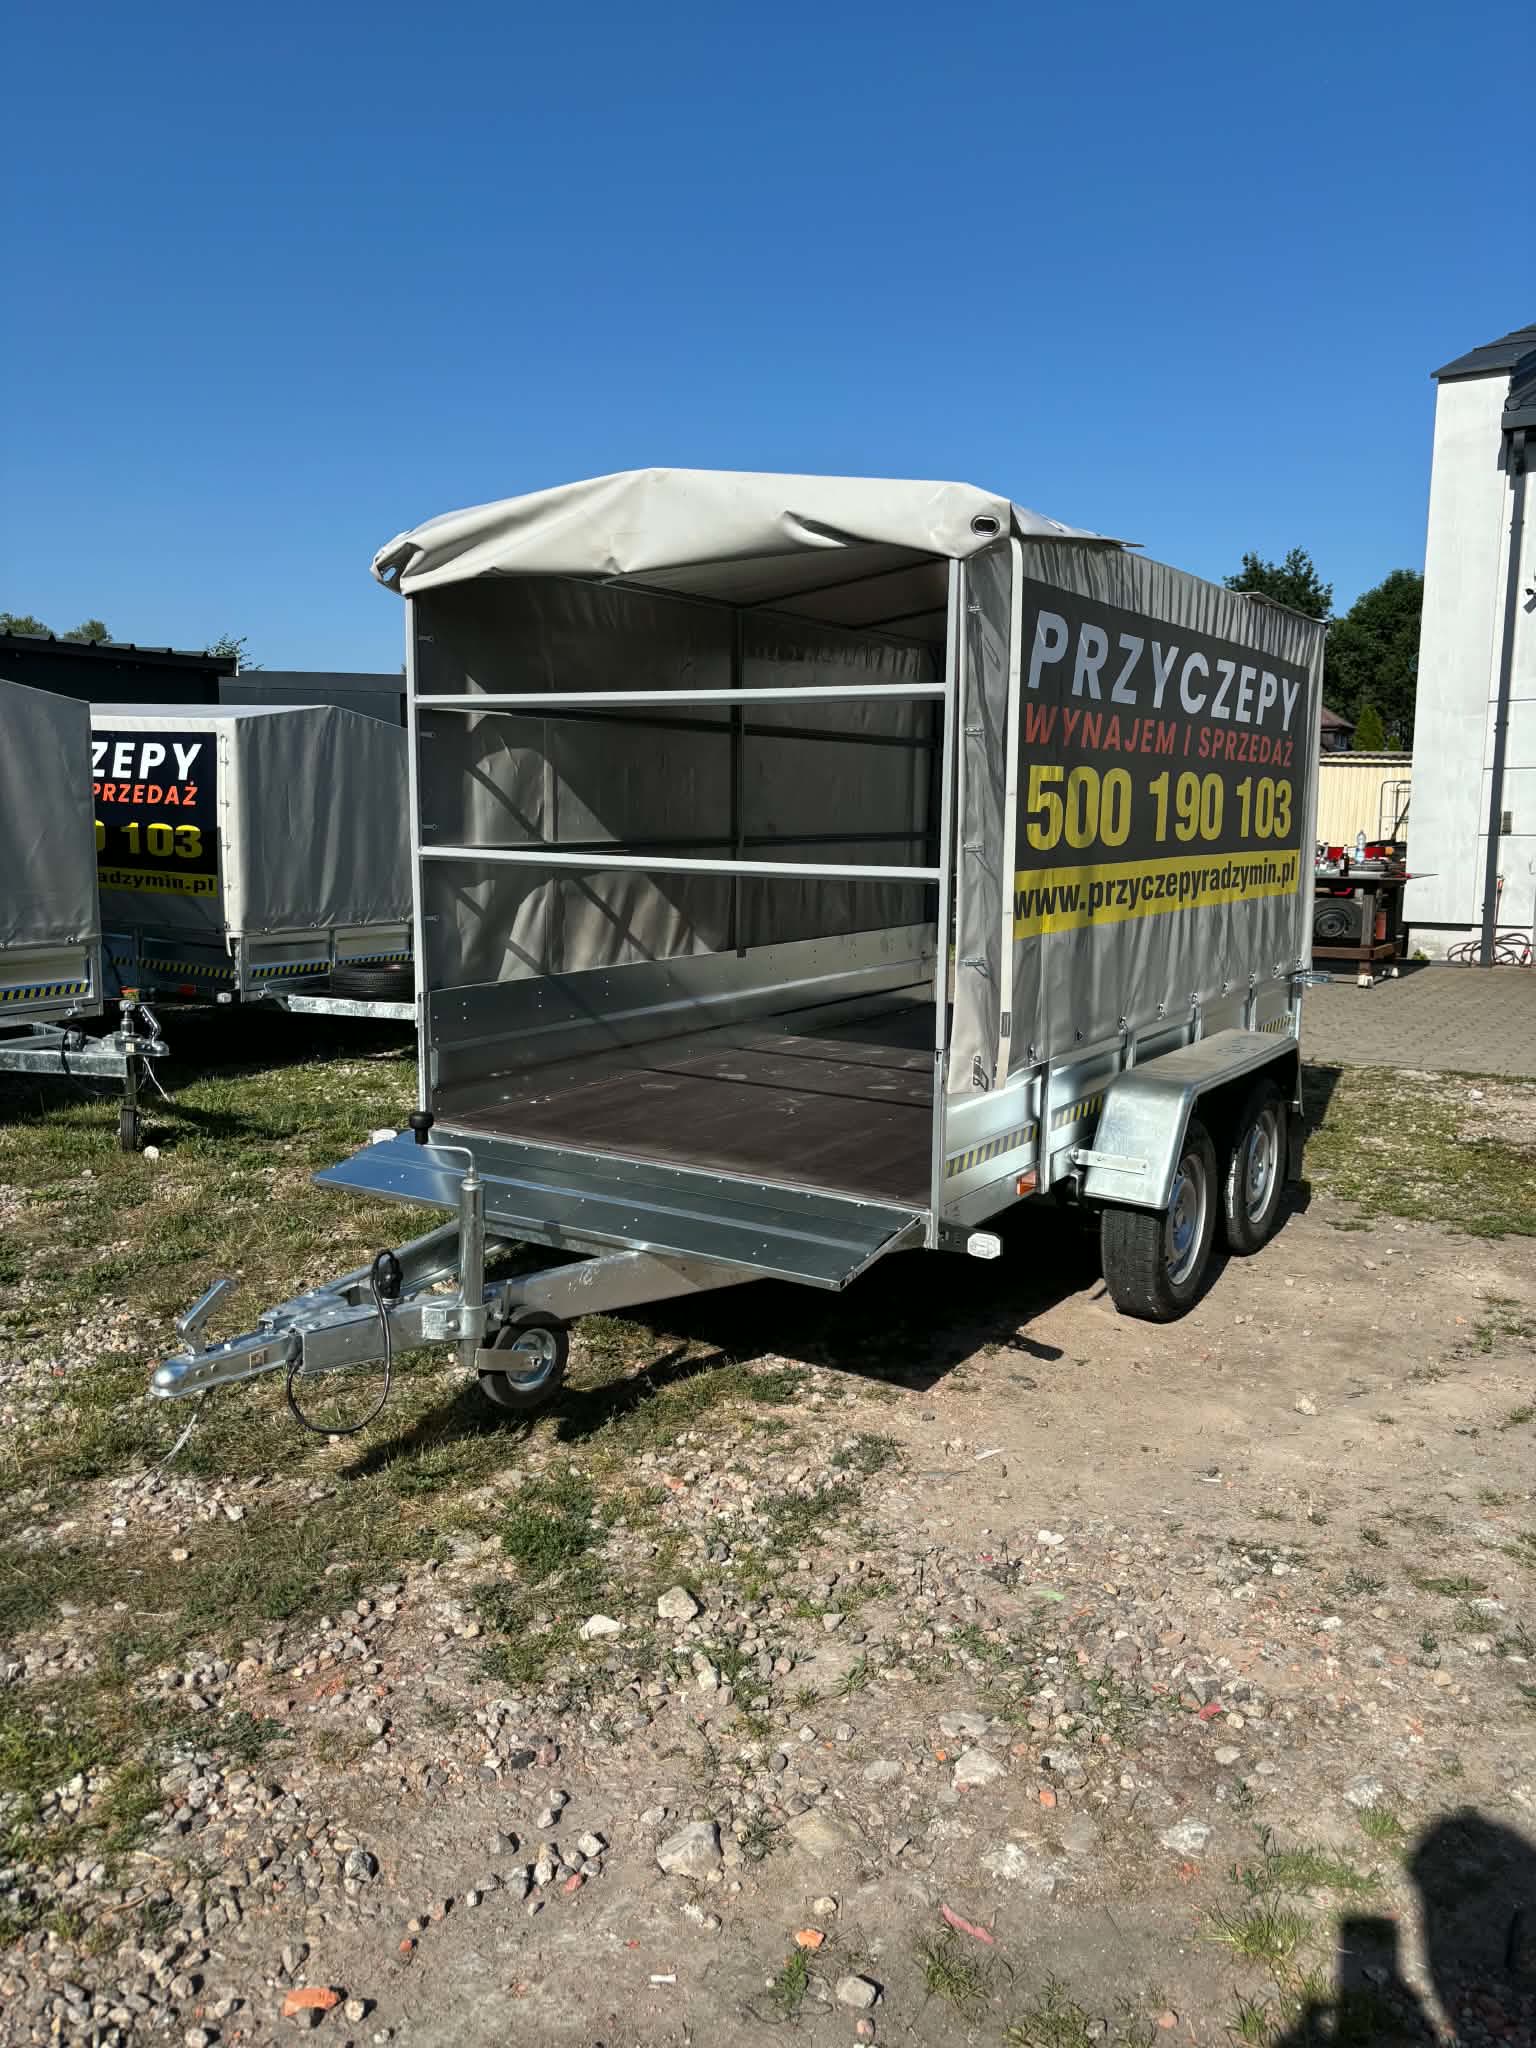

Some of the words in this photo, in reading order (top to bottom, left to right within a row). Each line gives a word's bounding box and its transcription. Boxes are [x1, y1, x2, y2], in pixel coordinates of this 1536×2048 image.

[1027, 609, 1300, 732] PRZYCZEPY
[1025, 702, 1177, 757] WYNAJEM
[1183, 724, 1192, 757] I
[1199, 726, 1294, 767] SPRZEDAŻ
[1025, 764, 1133, 851] 500
[1149, 771, 1225, 842] 190
[1236, 776, 1292, 839] 103
[120, 822, 203, 859] 103
[1014, 857, 1295, 921] www.przyczepyradzymin.pl
